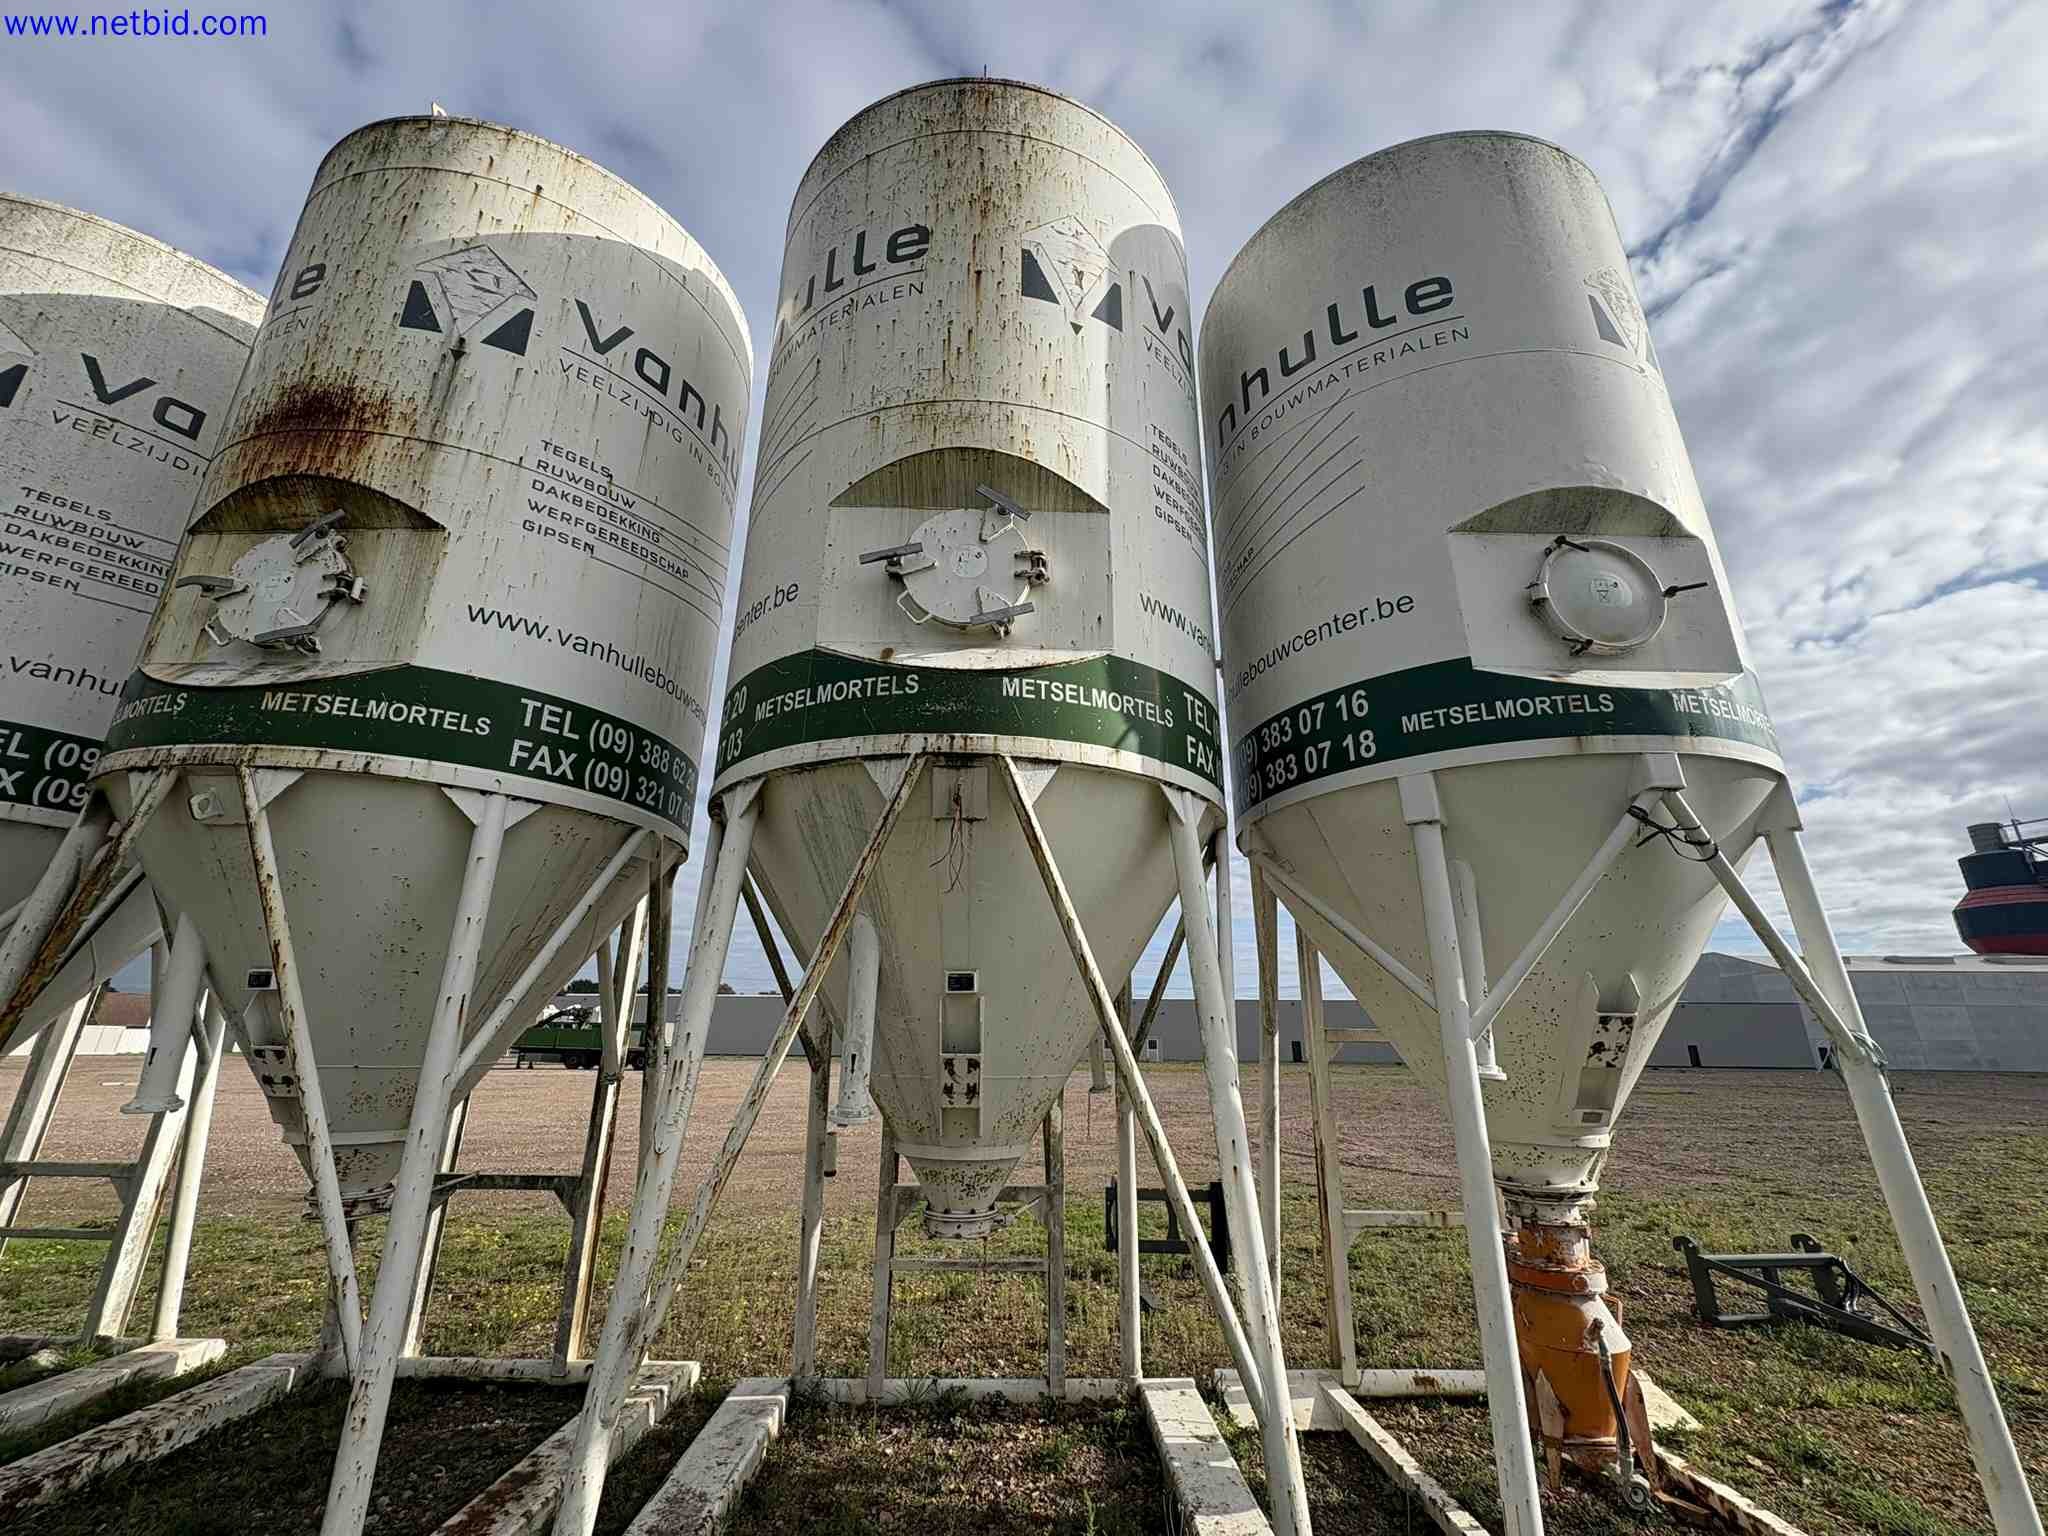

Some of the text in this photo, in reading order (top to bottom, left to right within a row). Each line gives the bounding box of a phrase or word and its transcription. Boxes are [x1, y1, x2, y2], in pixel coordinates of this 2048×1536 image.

[1250, 327, 1471, 441] BOUWMATERIALEN
[558, 357, 682, 443] VEELZIJDIG
[689, 442, 703, 464] IN
[541, 439, 612, 478] TEGELS
[21, 486, 112, 521] TEGELS
[536, 459, 636, 509] RUWBOUW
[13, 504, 144, 549] RUWBOUW
[522, 519, 595, 555] GIPSEN
[532, 480, 661, 544] DAKBEDEKKING
[528, 498, 690, 580] WERFGEREEDSCHAP
[260, 691, 491, 736] METSELMORTELS
[754, 674, 919, 722] METSELMORTELS
[1002, 677, 1174, 728] METSELMORTELS
[1183, 692, 1213, 736] TEL
[1261, 716, 1292, 754] 383
[1299, 702, 1326, 735] 07
[1336, 689, 1369, 722] 16
[1401, 694, 1615, 734] METSELMORTELS
[521, 698, 580, 740] TEL
[589, 719, 634, 764] (09)
[640, 740, 670, 774] 388
[1186, 735, 1216, 779] FAX
[1266, 753, 1298, 789] 383
[1304, 740, 1332, 774] 07
[1342, 729, 1377, 762] 18
[509, 739, 578, 780] FAX
[584, 758, 630, 801] (09)
[636, 776, 665, 809] 321
